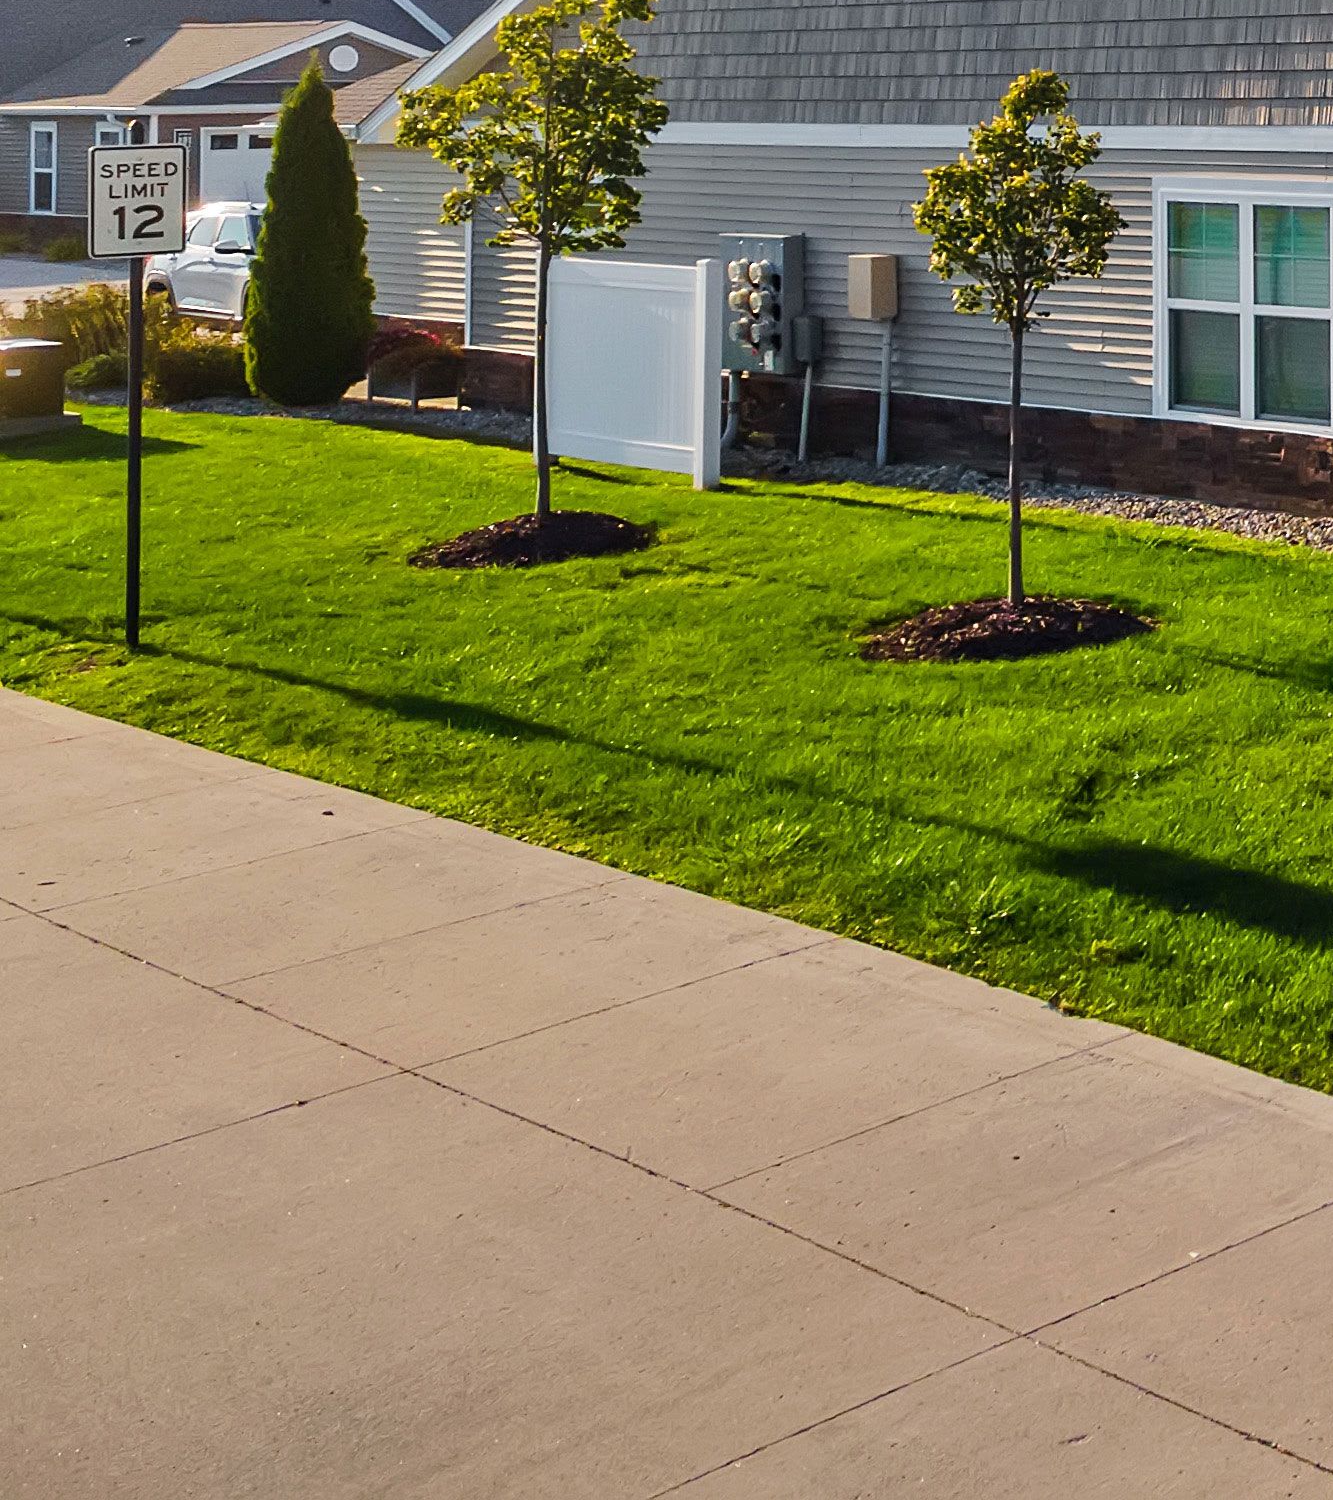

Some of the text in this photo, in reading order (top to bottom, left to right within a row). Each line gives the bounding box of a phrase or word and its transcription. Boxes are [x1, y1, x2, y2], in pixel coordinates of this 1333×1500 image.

[100, 162, 178, 178] SPEED
[109, 183, 168, 199] LIMIT
[113, 204, 164, 240] 12
